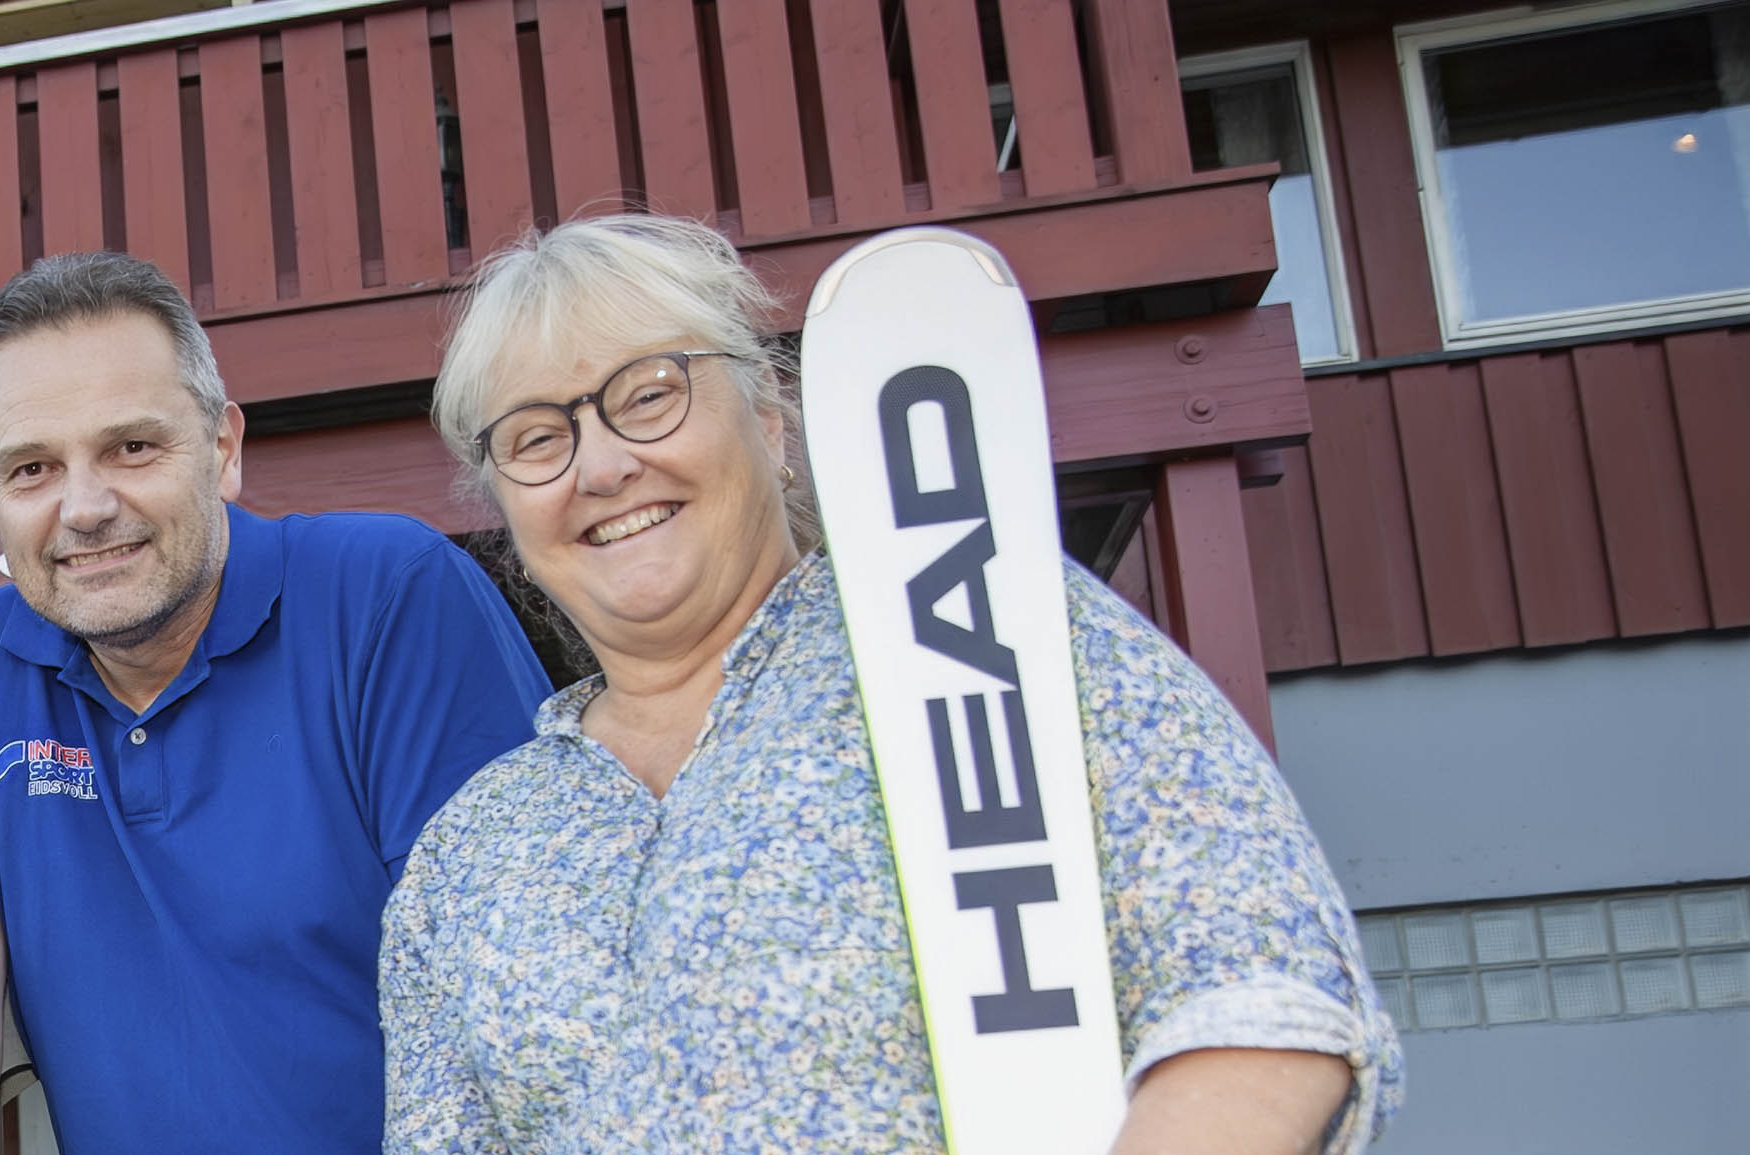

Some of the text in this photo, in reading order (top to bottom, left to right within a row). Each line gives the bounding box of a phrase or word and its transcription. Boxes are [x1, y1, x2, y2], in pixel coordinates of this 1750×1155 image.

[876, 364, 1080, 1036] HEAD
[27, 739, 94, 768] INTER
[28, 758, 96, 787] SPORT
[27, 780, 99, 800] EIDSVOLL
